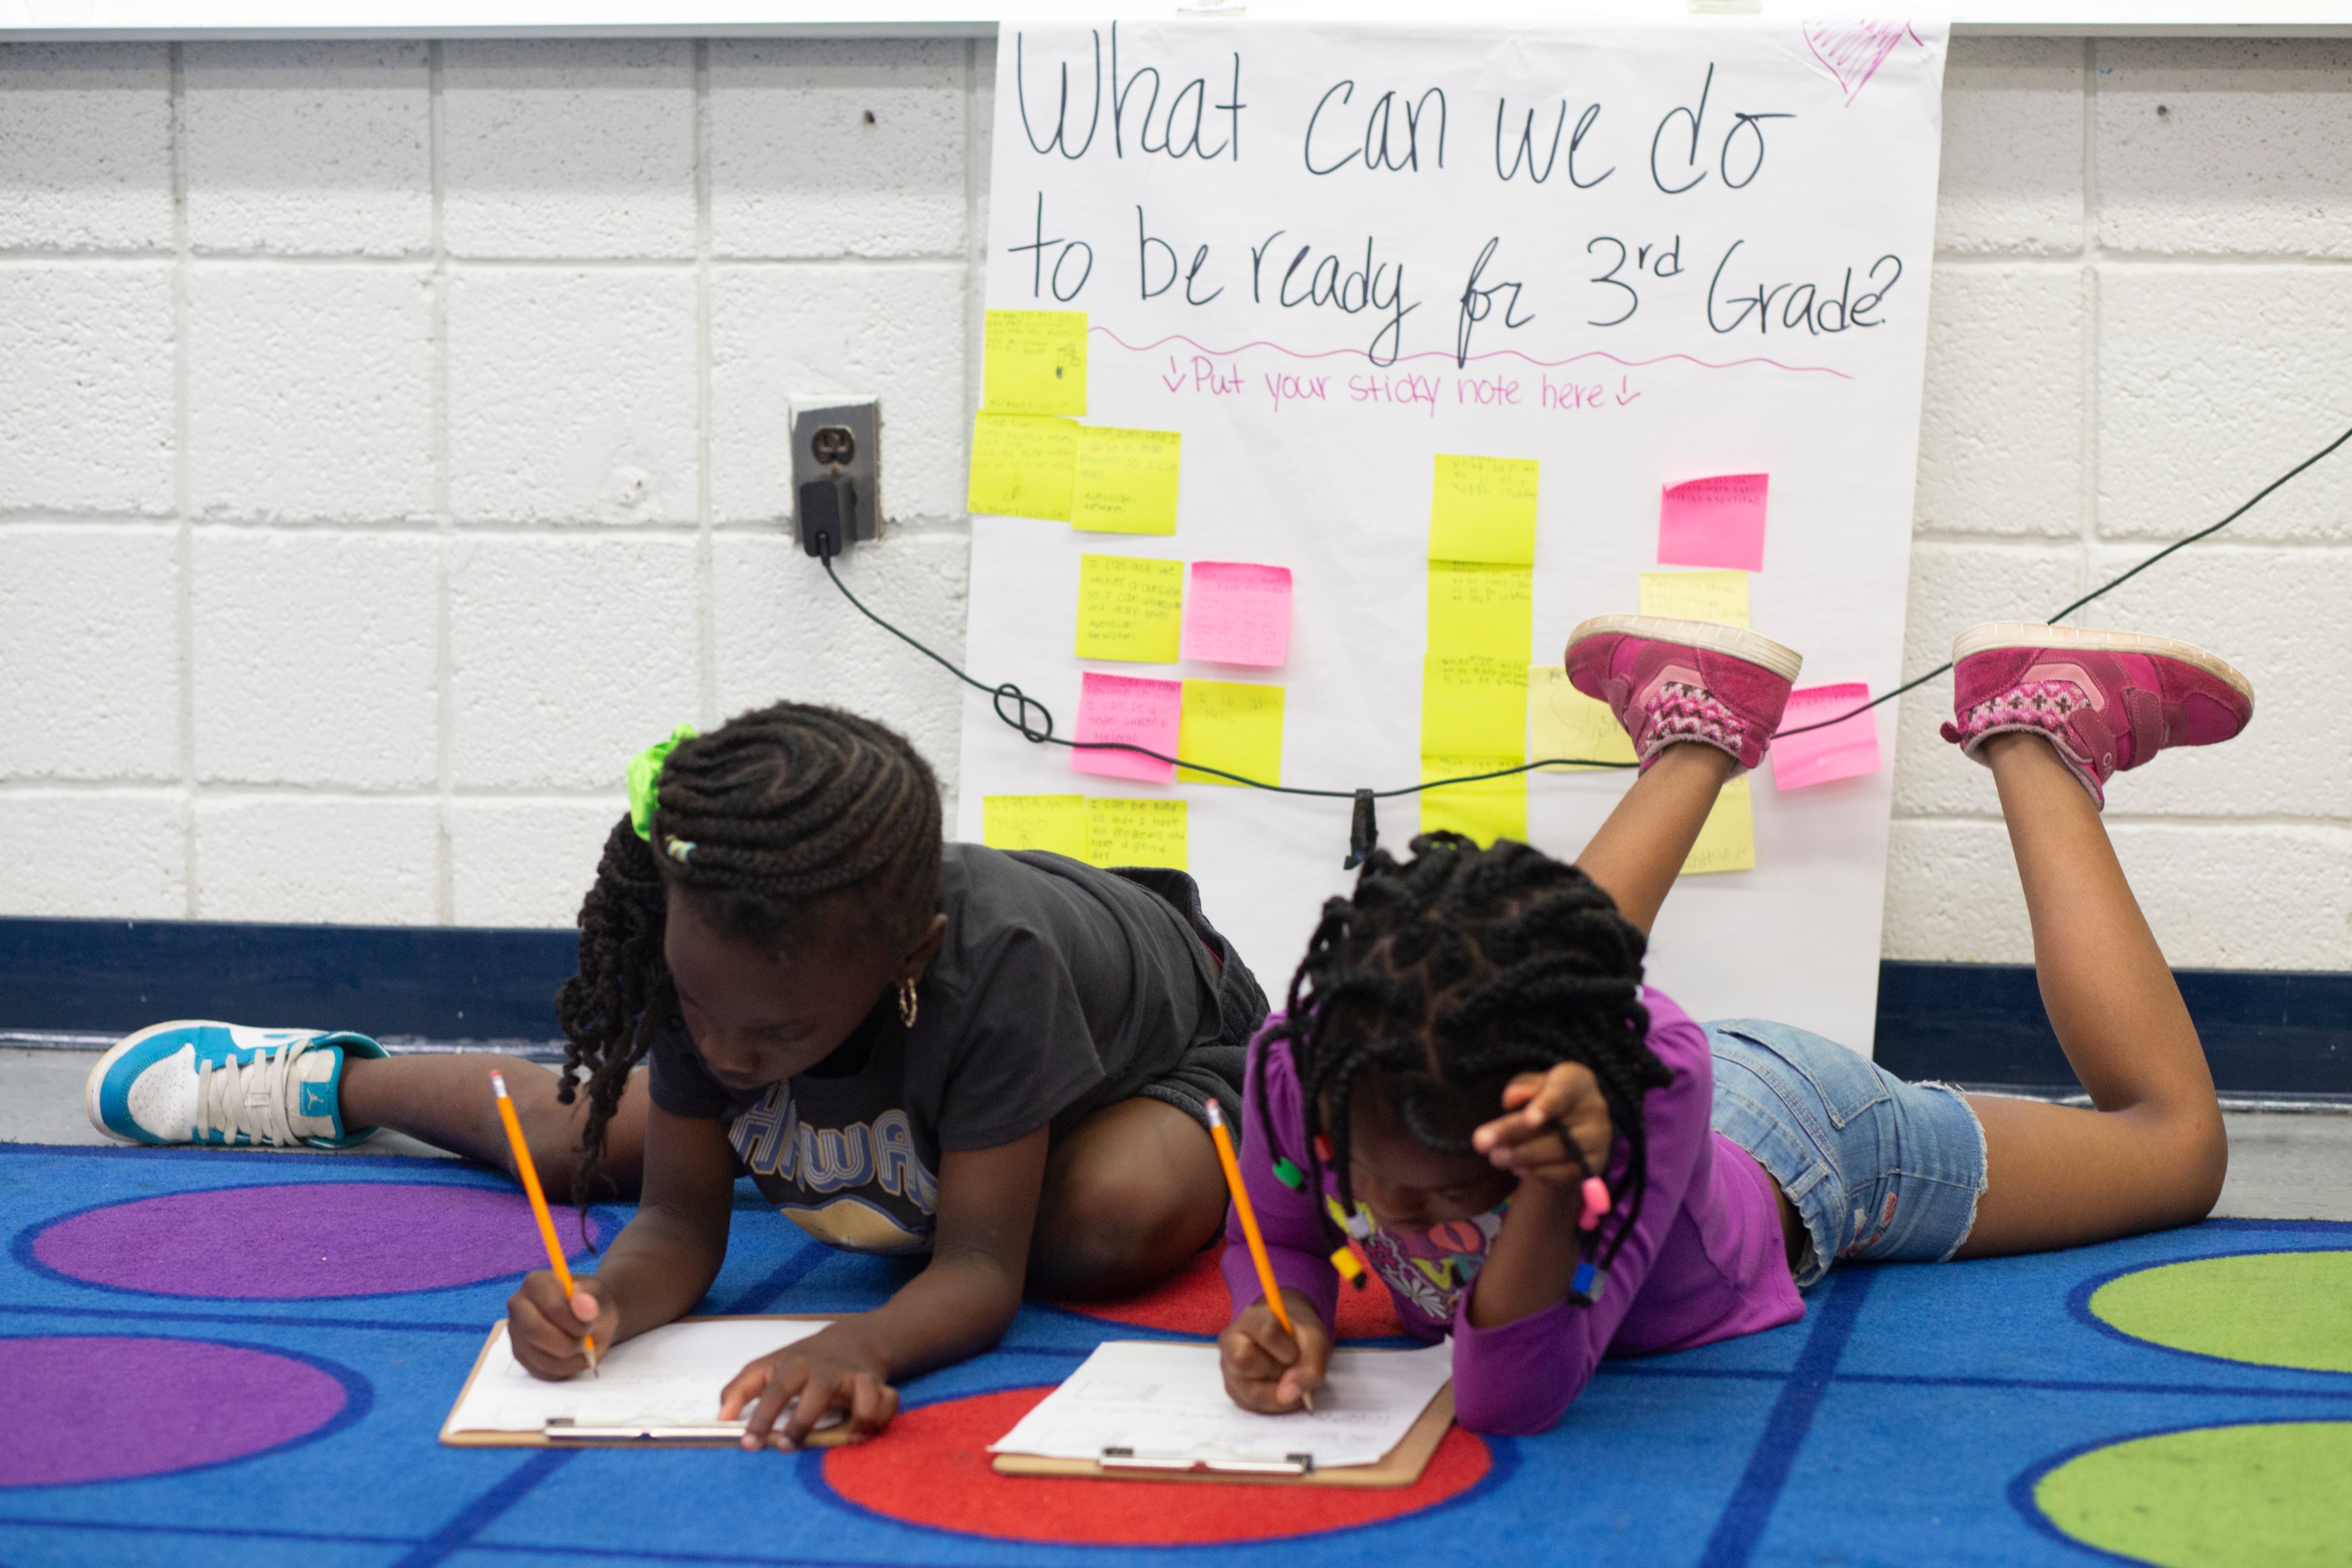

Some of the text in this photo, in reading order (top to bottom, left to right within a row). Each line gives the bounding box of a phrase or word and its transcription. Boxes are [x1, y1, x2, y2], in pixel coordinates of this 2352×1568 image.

[1017, 21, 1797, 194] What can we do
[1008, 191, 1902, 369] to be ready for 3rd Grade?
[1191, 356, 1605, 417] Put your sticky note here
